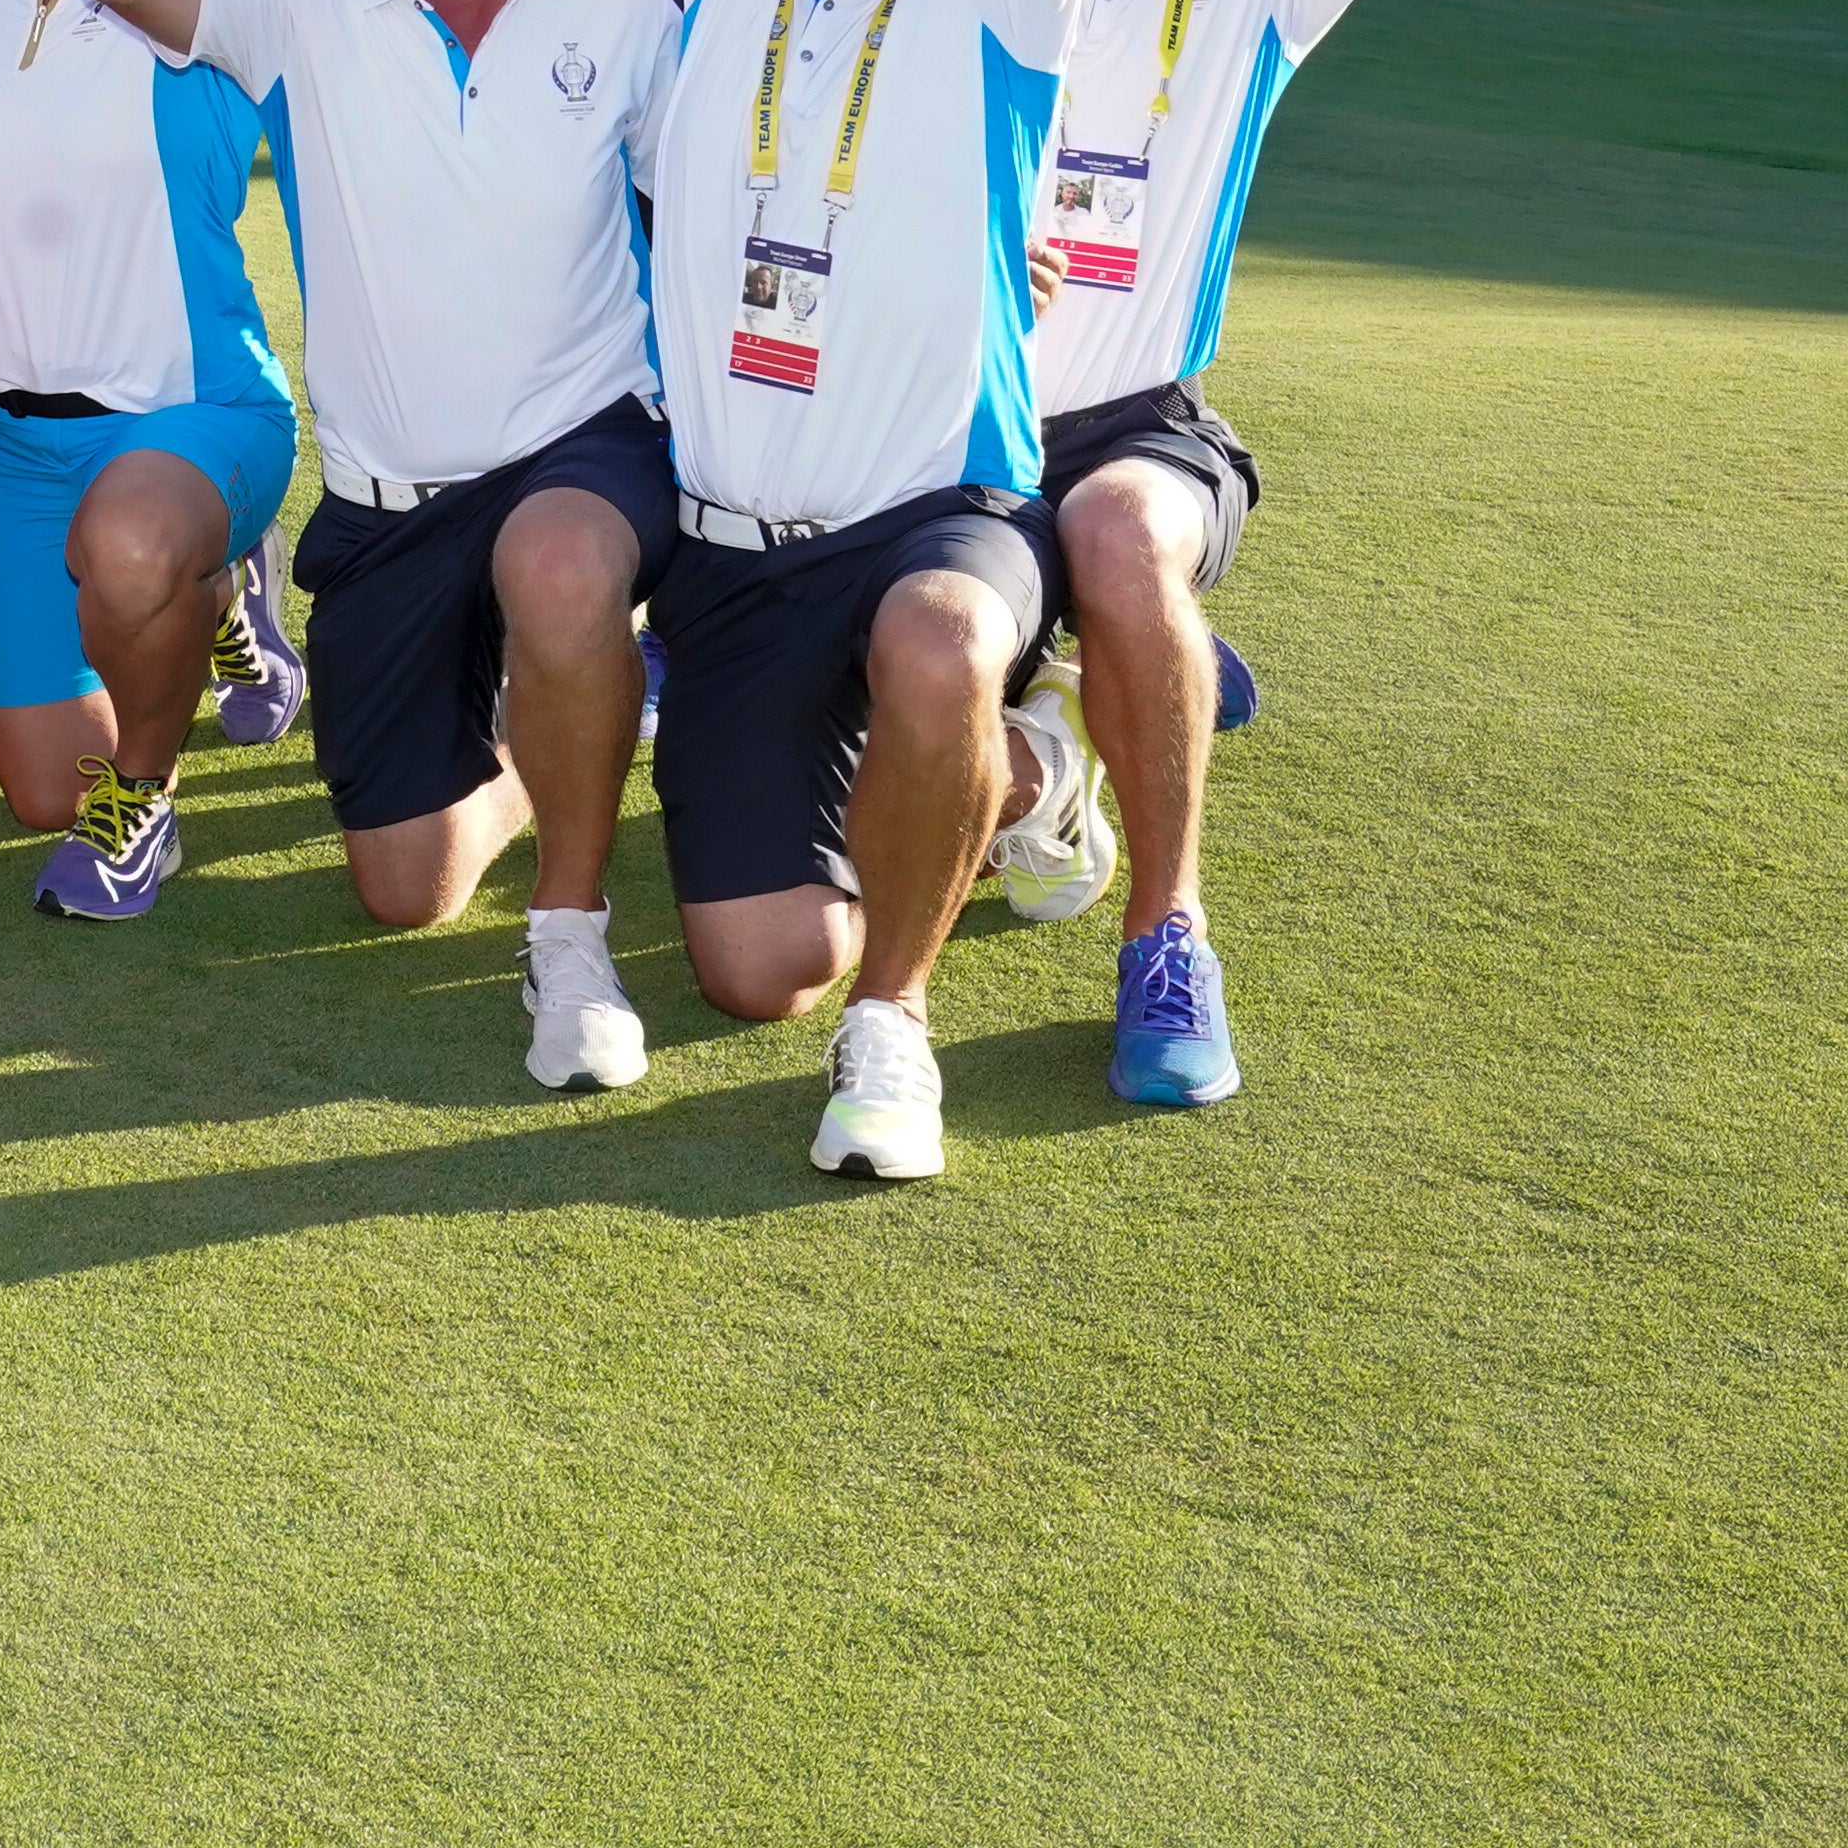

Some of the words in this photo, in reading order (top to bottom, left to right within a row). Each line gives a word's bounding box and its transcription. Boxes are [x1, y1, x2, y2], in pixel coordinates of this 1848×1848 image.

[1167, 24, 1179, 51] TEAM
[760, 48, 779, 106] EUROPE
[759, 109, 771, 153] TEAM
[838, 121, 857, 164] TEAM
[848, 57, 876, 118] EUROPE
